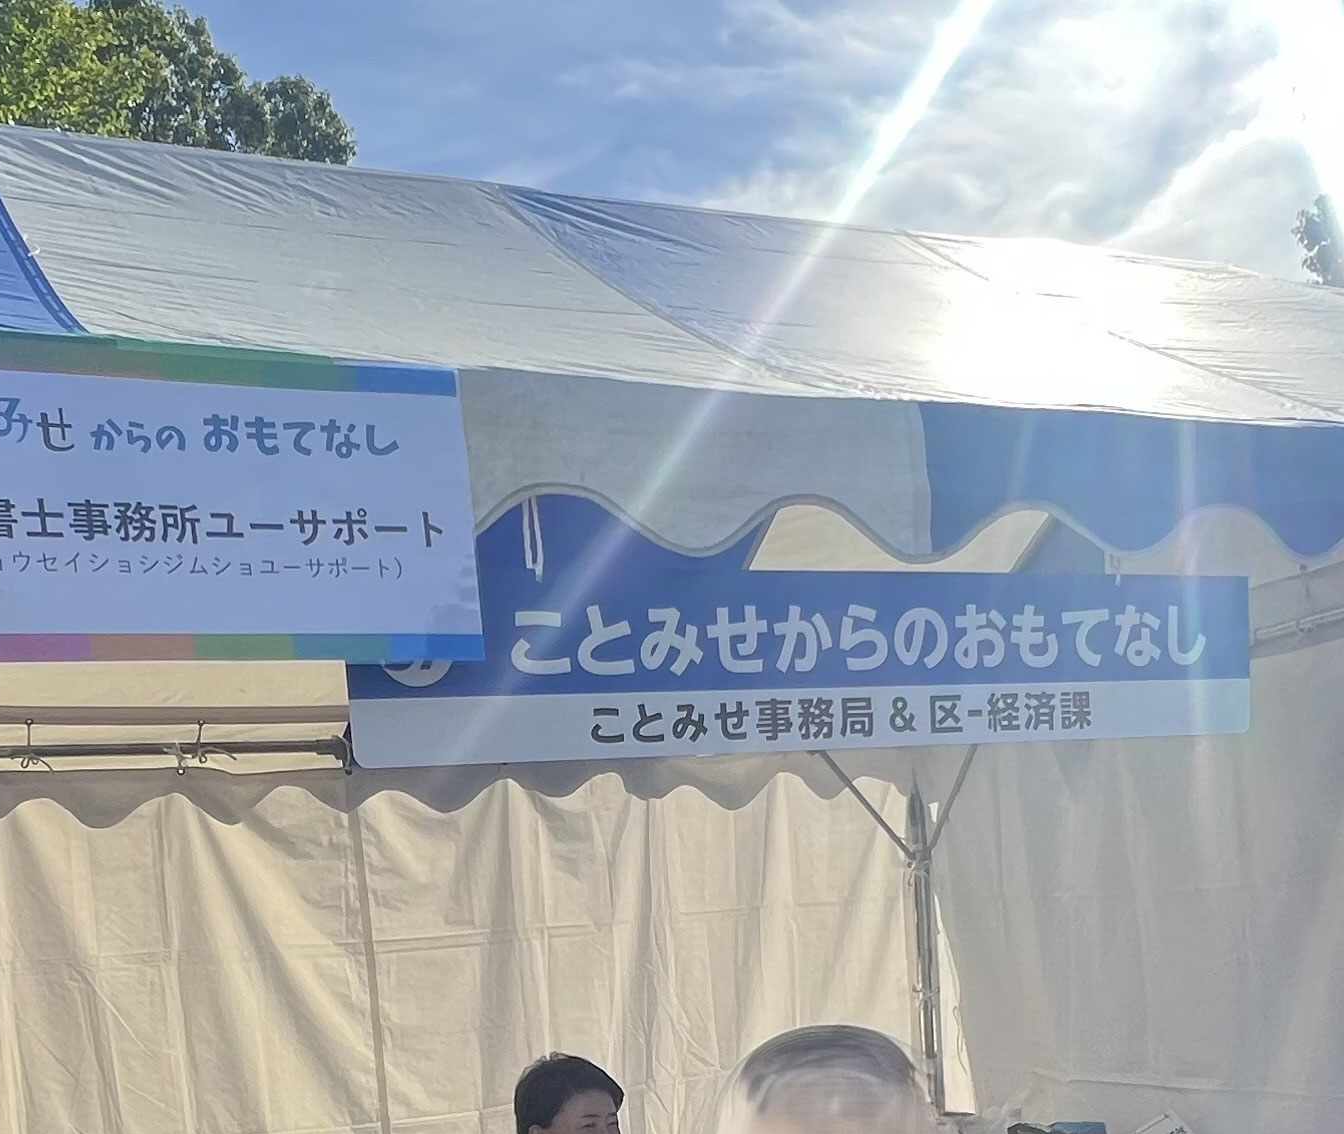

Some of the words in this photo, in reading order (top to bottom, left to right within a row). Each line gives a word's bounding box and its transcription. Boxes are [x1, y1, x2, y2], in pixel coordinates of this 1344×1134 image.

[90, 419, 186, 455] からの
[203, 414, 399, 459] おもてなし
[510, 600, 1208, 675] ことみせからのおもてなし
[589, 699, 873, 745] ことみせ事務局
